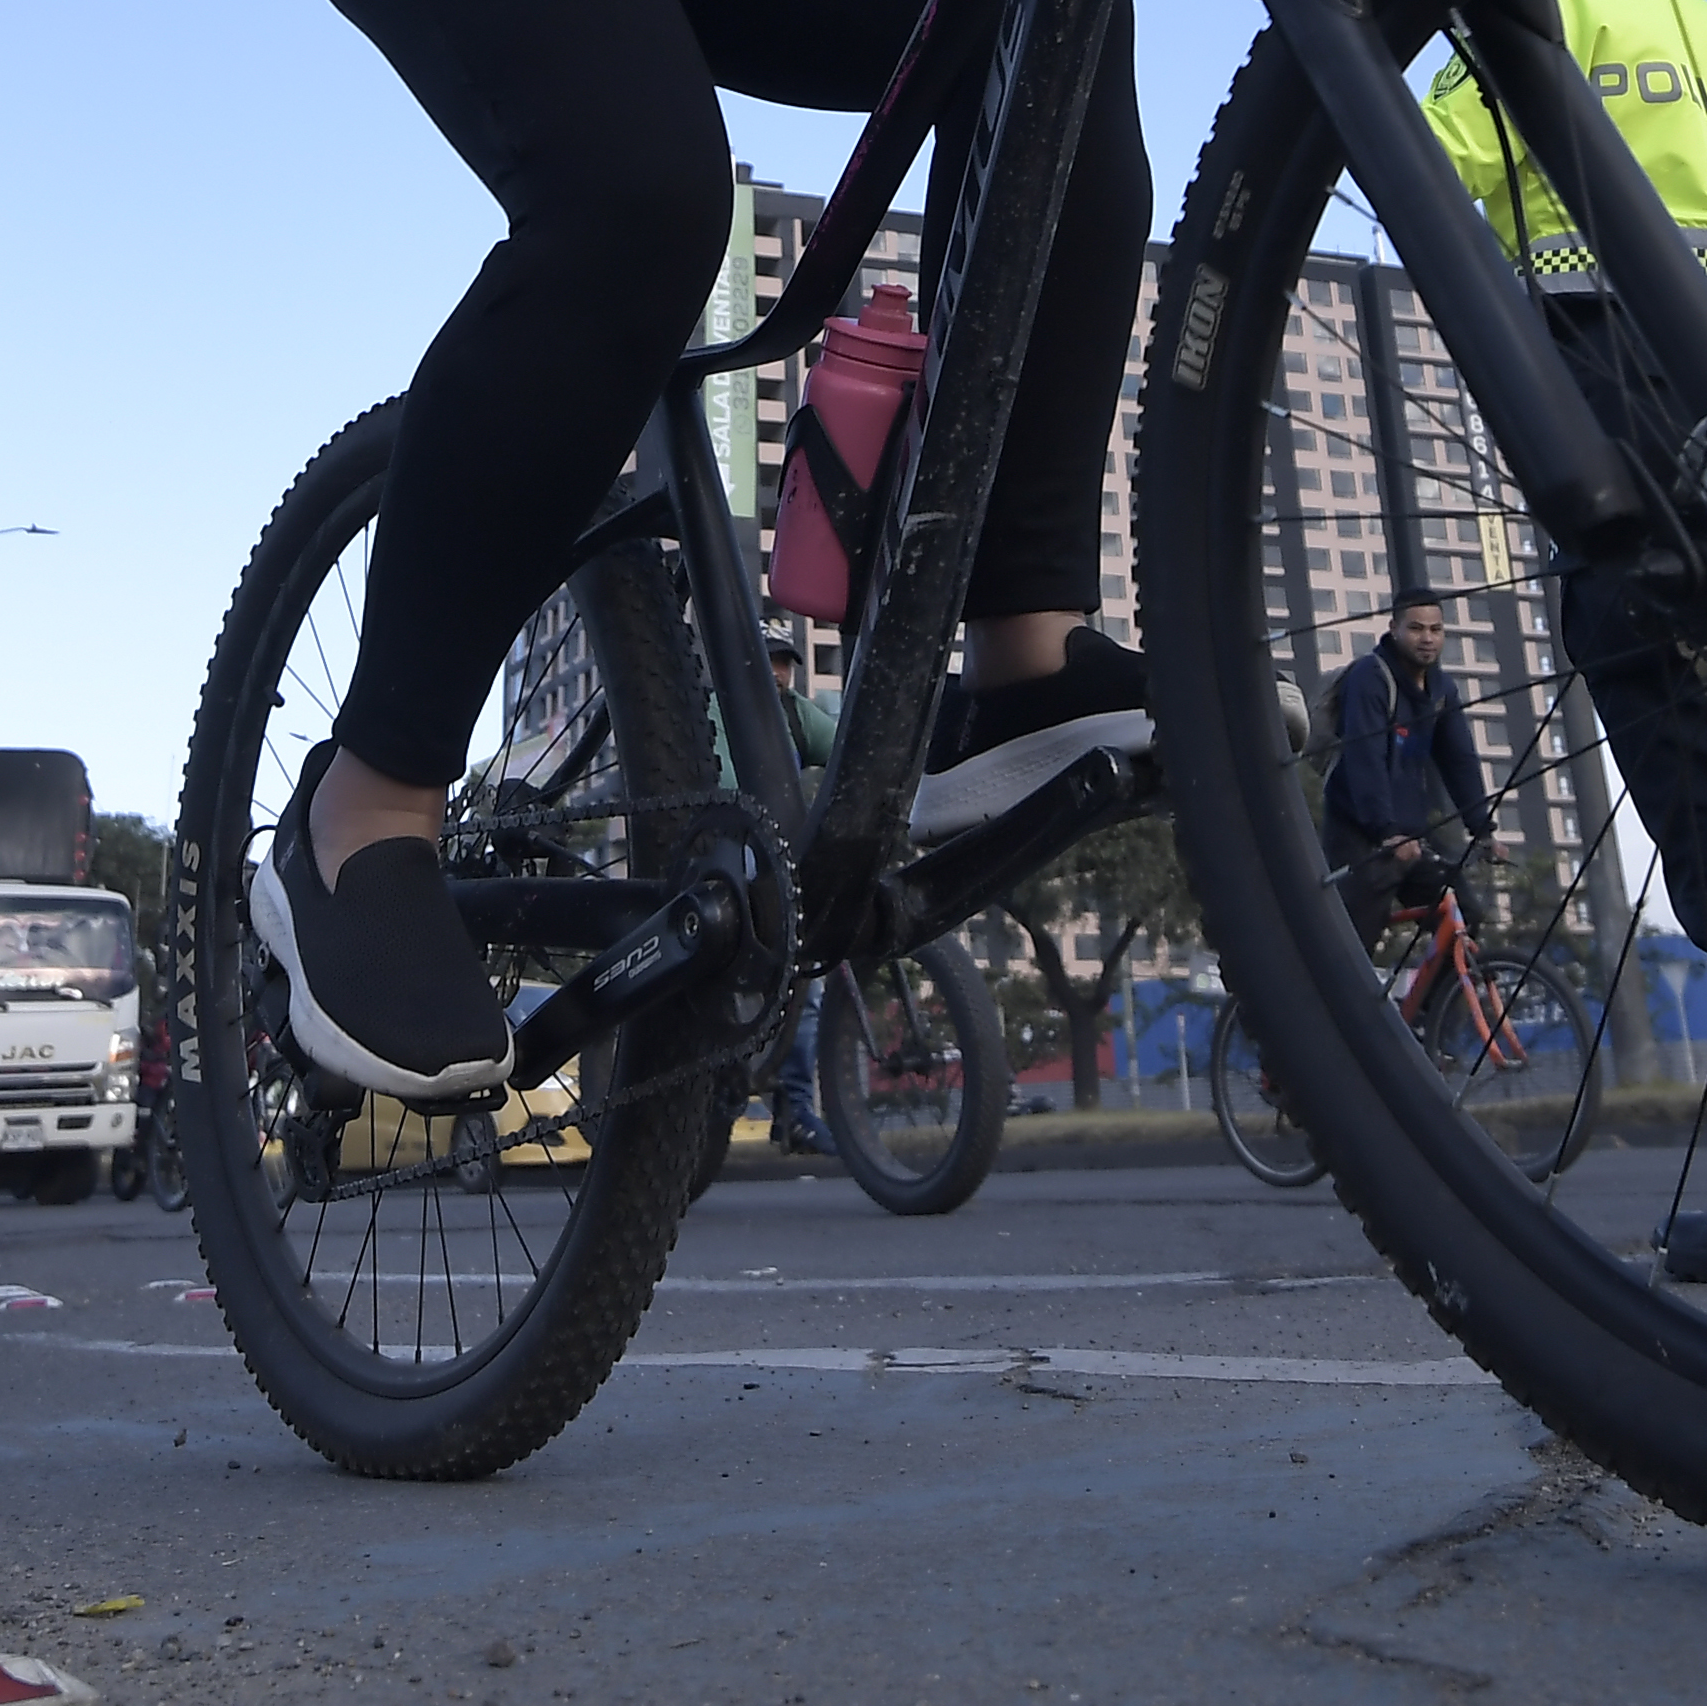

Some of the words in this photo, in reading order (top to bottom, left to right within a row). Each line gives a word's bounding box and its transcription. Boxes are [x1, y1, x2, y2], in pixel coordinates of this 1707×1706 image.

[1174, 264, 1228, 390] IKON
[713, 372, 731, 386] D
[713, 391, 731, 458] SALA
[178, 839, 202, 1083] MAXXIS
[593, 935, 660, 993] CUES
[1, 1044, 55, 1060] JAC
